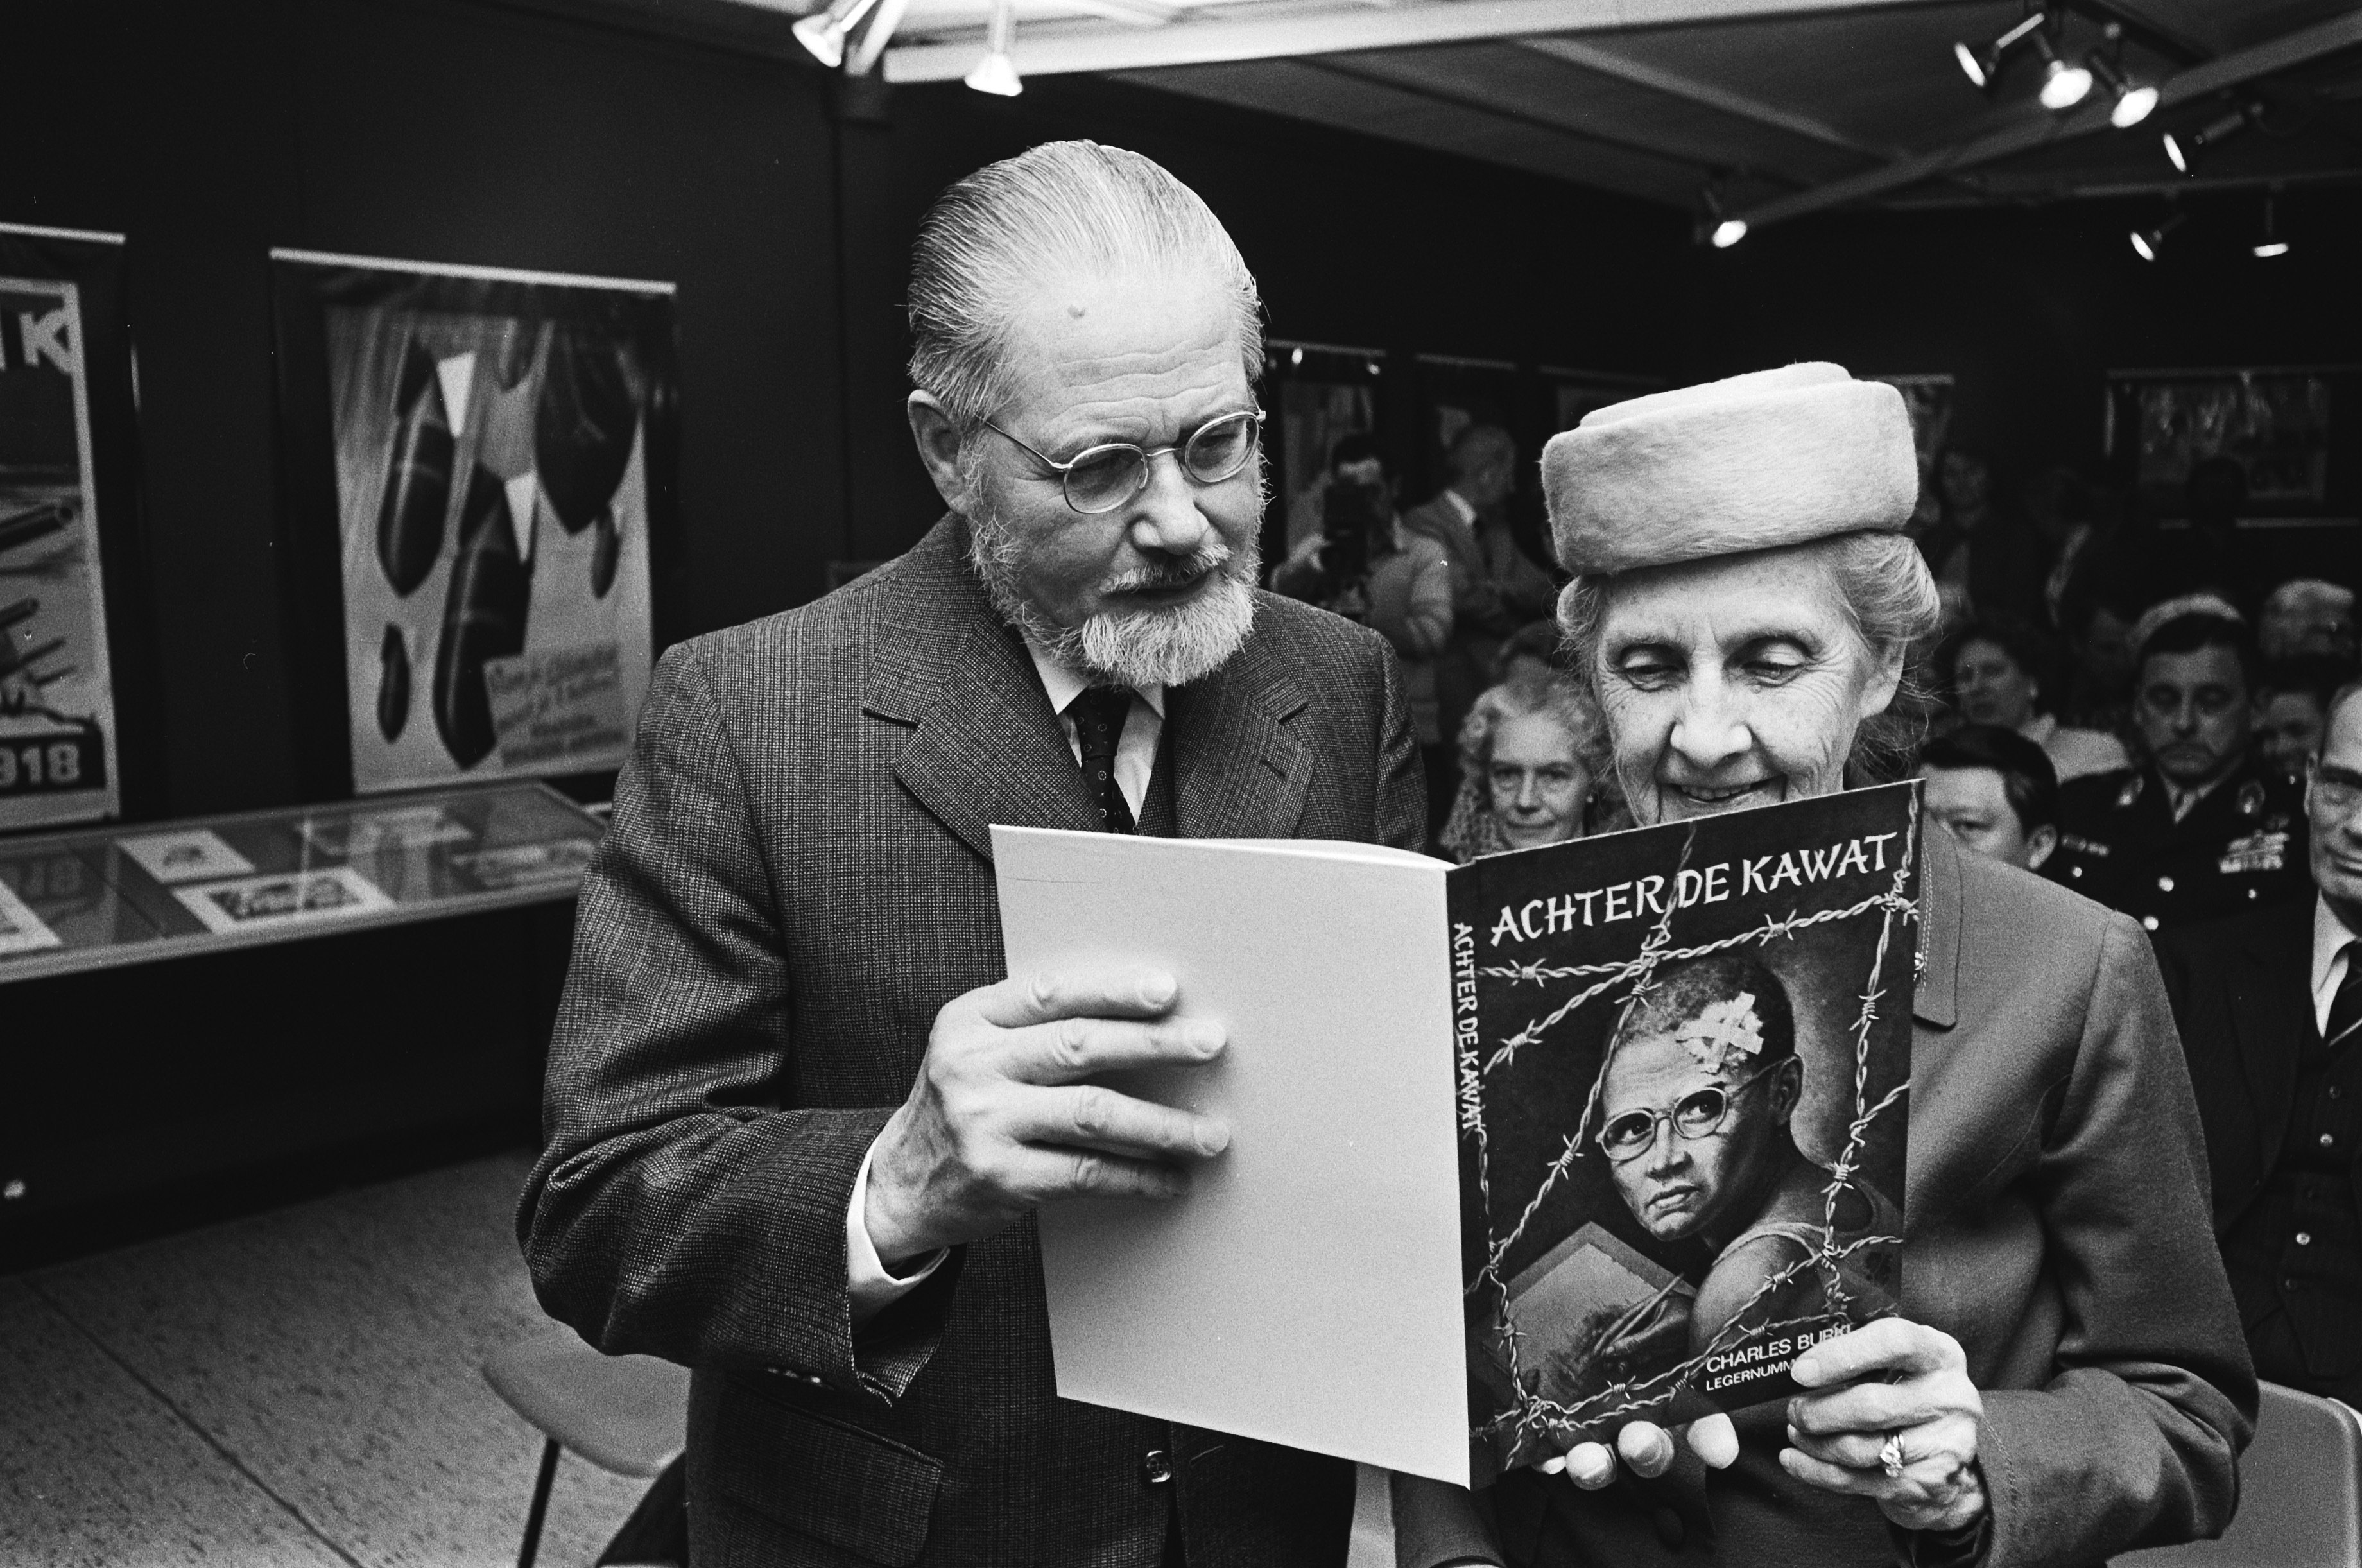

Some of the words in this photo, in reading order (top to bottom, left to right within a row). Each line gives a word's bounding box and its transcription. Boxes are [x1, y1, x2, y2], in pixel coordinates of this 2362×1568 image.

[1490, 875, 1666, 947] ACHTER
[1677, 863, 1730, 908] DE
[1741, 832, 1898, 896] KAWAT
[1453, 922, 1478, 1015] ACHTER
[1458, 1017, 1479, 1048] DE
[1459, 1050, 1482, 1130] KAWAT
[1706, 1338, 1791, 1373] CHARLES
